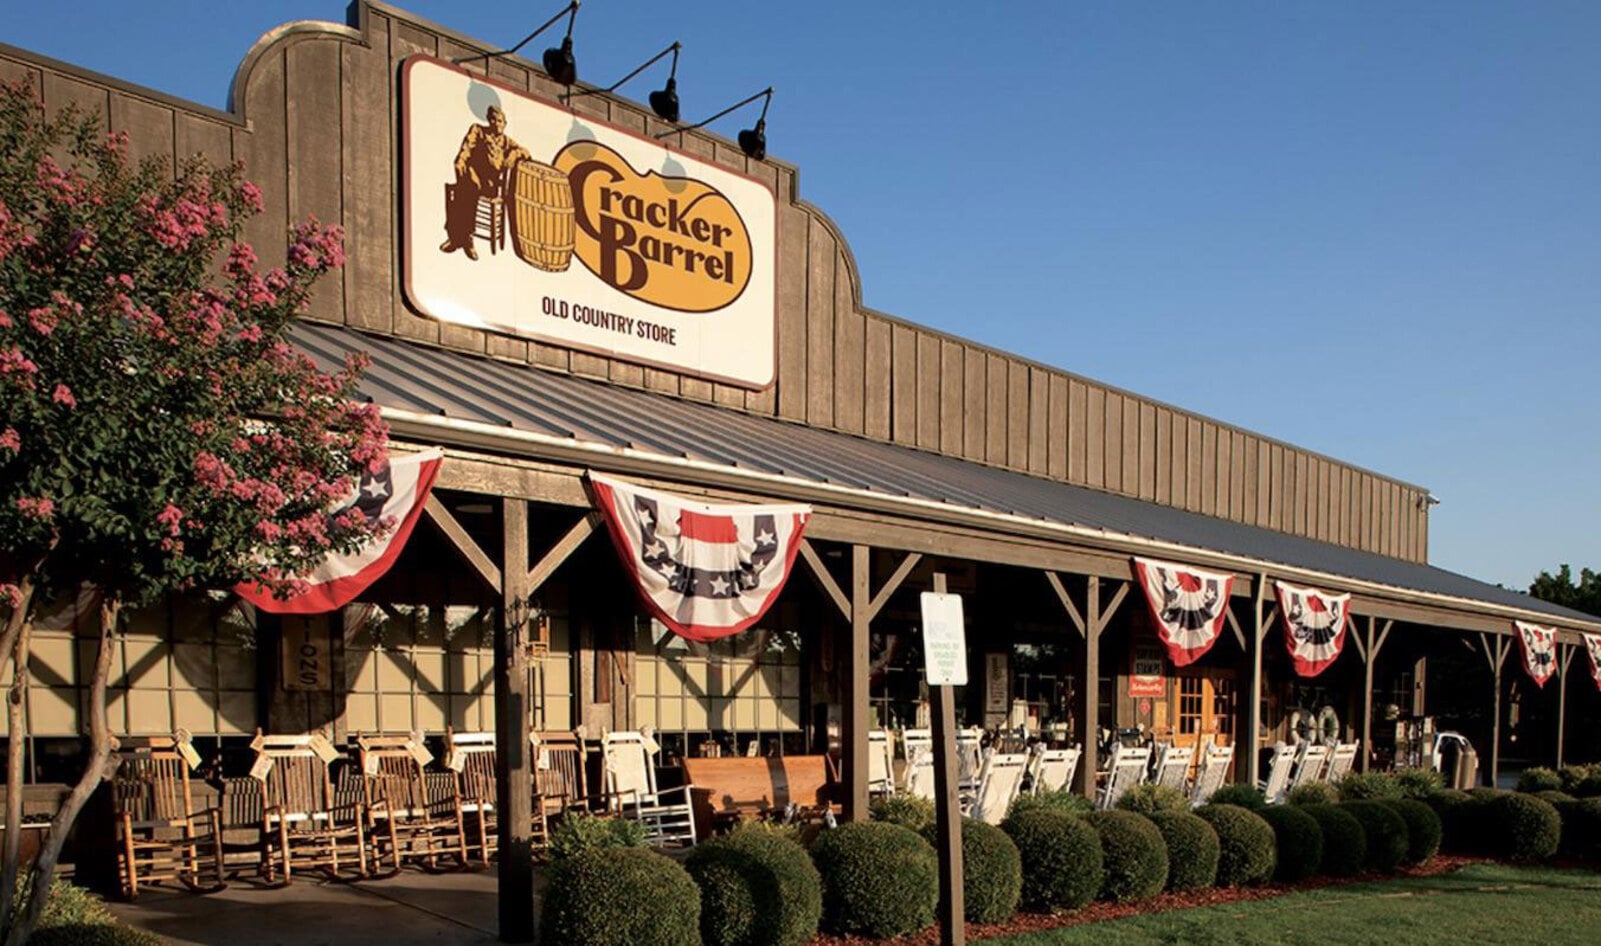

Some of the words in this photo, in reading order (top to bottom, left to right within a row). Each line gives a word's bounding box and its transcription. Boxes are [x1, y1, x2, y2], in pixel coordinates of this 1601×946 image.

[568, 160, 732, 248] Cracker
[600, 213, 734, 291] Barrel
[542, 296, 569, 319] OLD
[573, 304, 634, 335] COUNTRY
[637, 320, 677, 346] STORE
